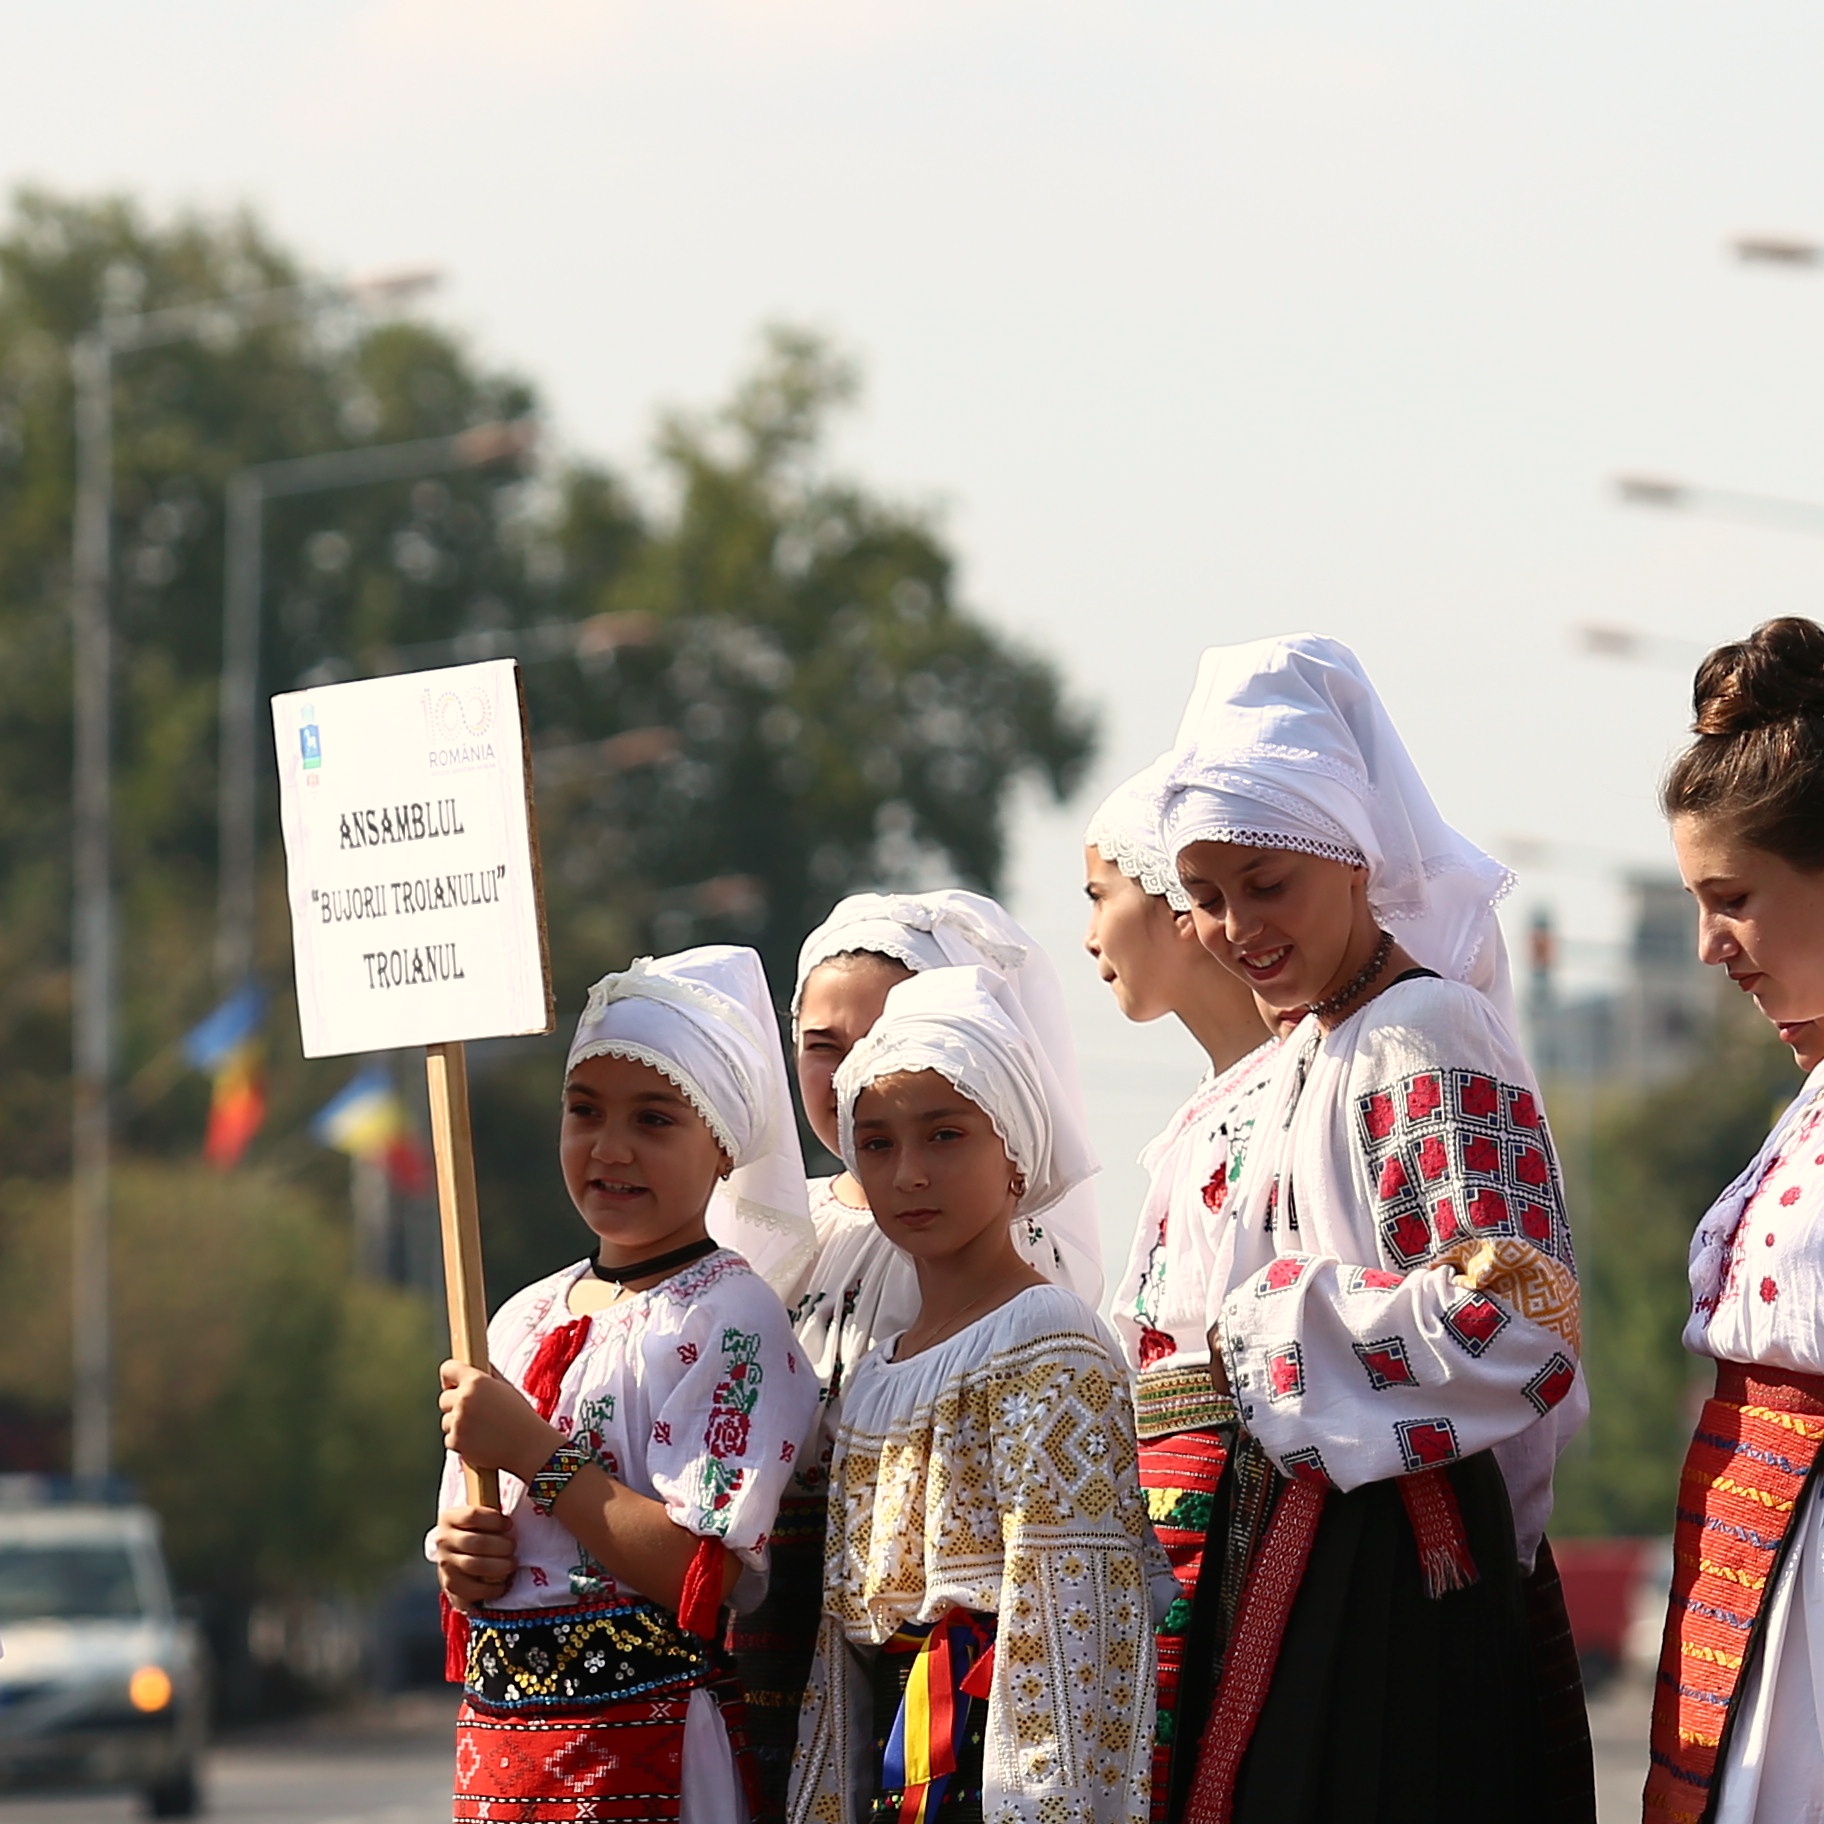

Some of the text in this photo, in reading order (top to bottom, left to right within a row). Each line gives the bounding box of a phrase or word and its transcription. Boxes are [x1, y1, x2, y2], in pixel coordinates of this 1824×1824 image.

[428, 742, 496, 768] ROMÂNIA
[339, 798, 464, 850] ANSAMBLUL
[363, 942, 465, 990] TROIANUL
